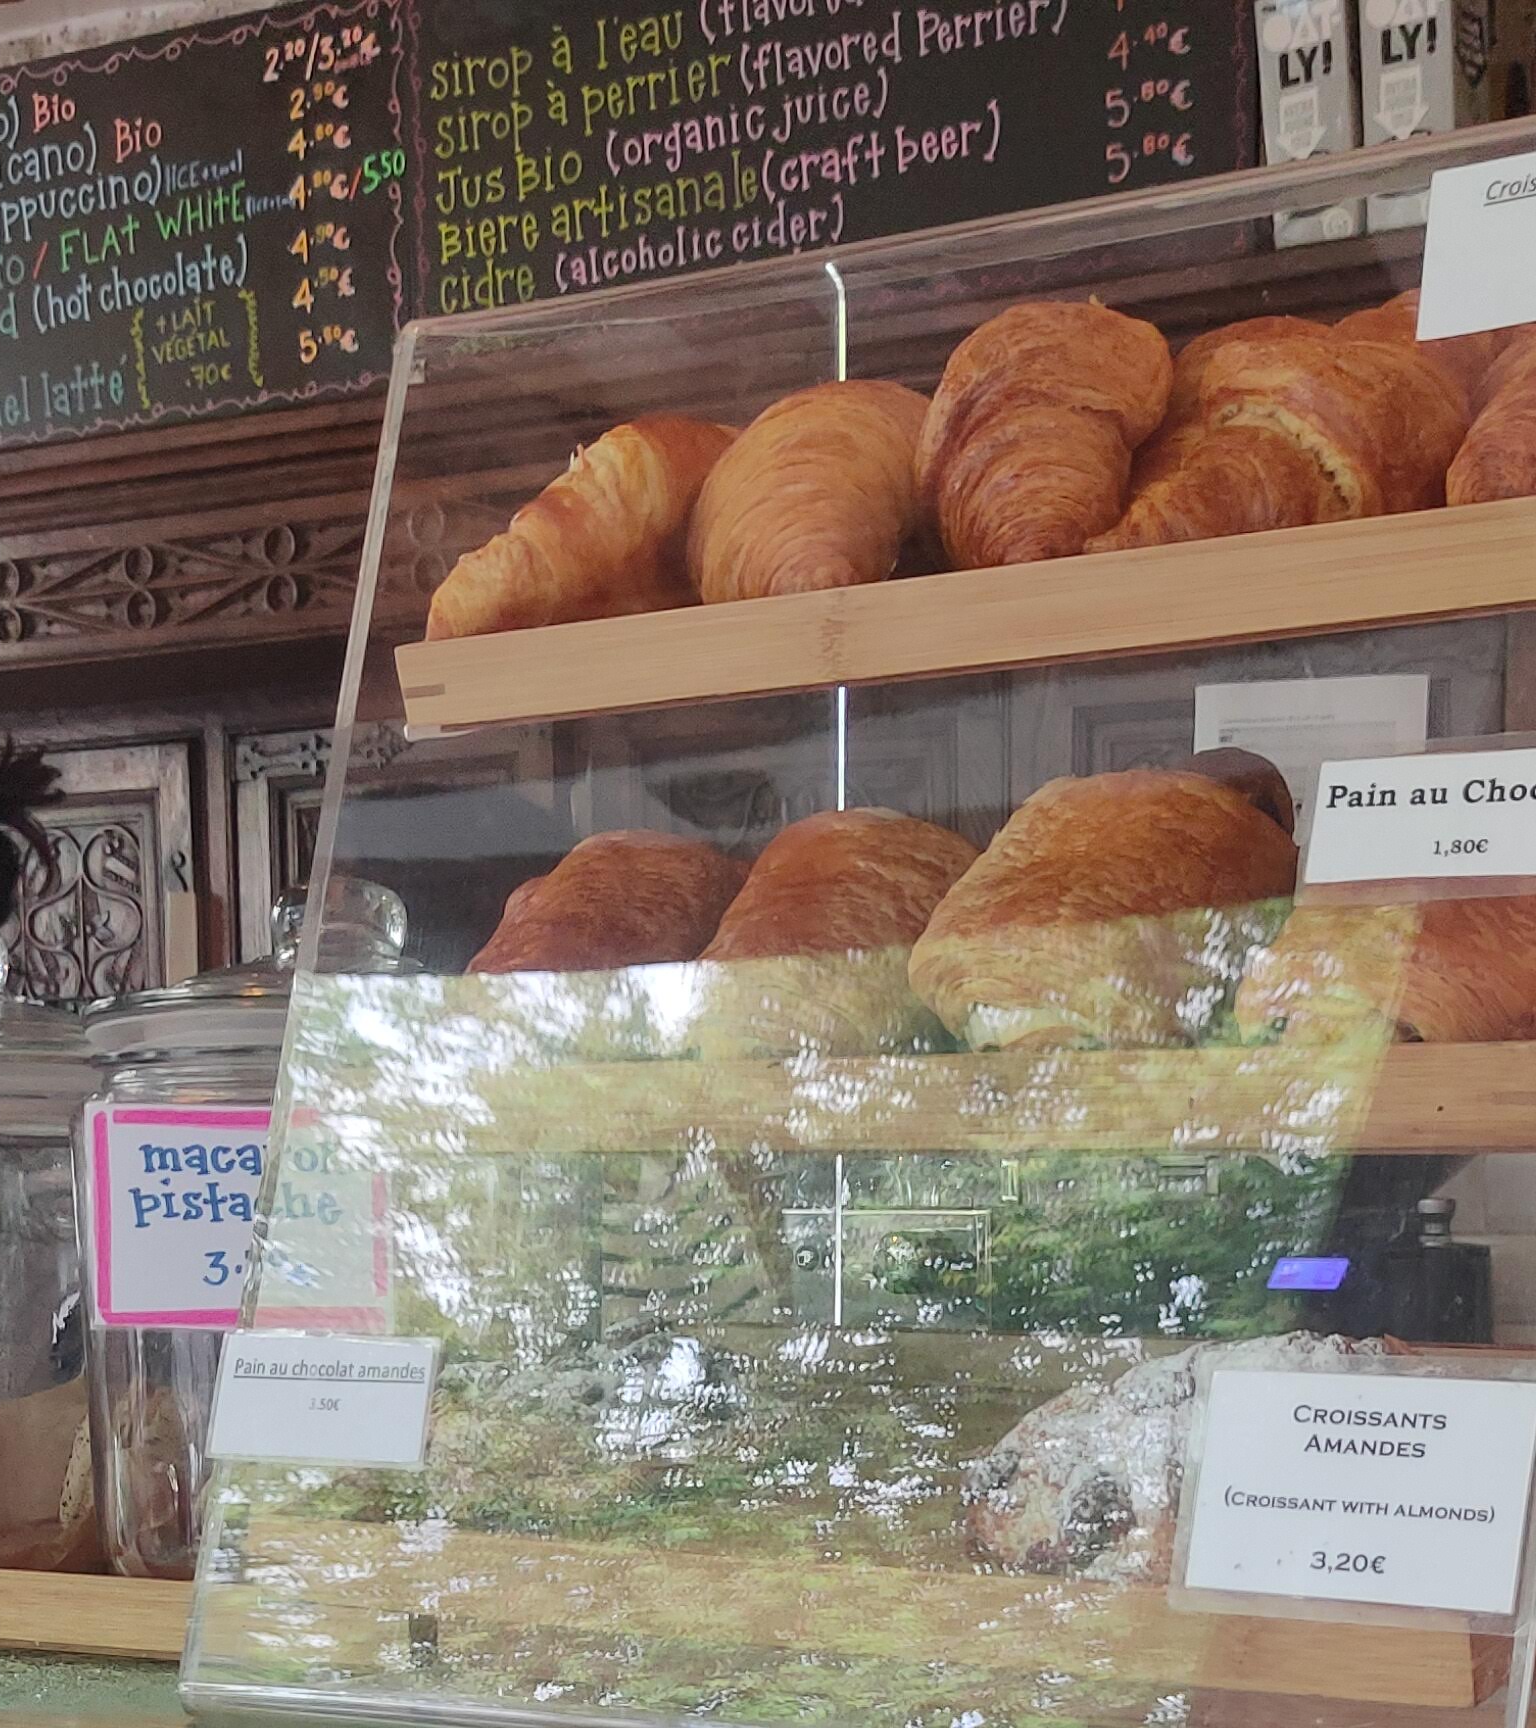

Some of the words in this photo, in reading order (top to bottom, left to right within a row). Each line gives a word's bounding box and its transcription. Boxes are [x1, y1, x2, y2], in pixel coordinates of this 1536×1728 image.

[431, 46, 533, 101] sirop
[552, 25, 573, 75] à
[597, 10, 683, 71] l'eau
[1279, 40, 1332, 89] LY!
[1379, 17, 1437, 65] LY!
[434, 101, 534, 160] sirop
[547, 80, 568, 126] à
[581, 53, 732, 137] perrier
[740, 11, 902, 96] (flavored
[32, 92, 76, 133] Bio
[114, 117, 162, 163] Bio
[435, 166, 505, 215] Jus
[516, 147, 583, 202] Bio
[606, 104, 765, 177] (organic
[772, 66, 888, 143] juice)
[551, 150, 758, 244] artisanale
[761, 131, 885, 203] (craft
[896, 99, 1001, 174] beer)
[440, 257, 535, 314] cidre
[555, 224, 724, 293] (alcoholic
[732, 192, 844, 252] cider)
[32, 272, 92, 335] (hot
[99, 231, 248, 314] chocolate)
[40, 353, 128, 420] latté
[1325, 782, 1398, 809] Pain
[1409, 786, 1449, 805] au
[1432, 838, 1490, 857] 1,80€
[128, 1177, 344, 1228] pistahe
[234, 1358, 266, 1376] Pain
[269, 1361, 288, 1376] au
[292, 1359, 354, 1378] chocolat
[358, 1361, 425, 1380] amandes
[1293, 1404, 1448, 1431] CROISSANTS
[1303, 1434, 1427, 1459] AMANDES
[1224, 1485, 1337, 1514] (CROISSANT
[1341, 1499, 1389, 1517] WITH
[1393, 1504, 1496, 1525] ALMONDS)
[1309, 1550, 1388, 1575] 3,20€
